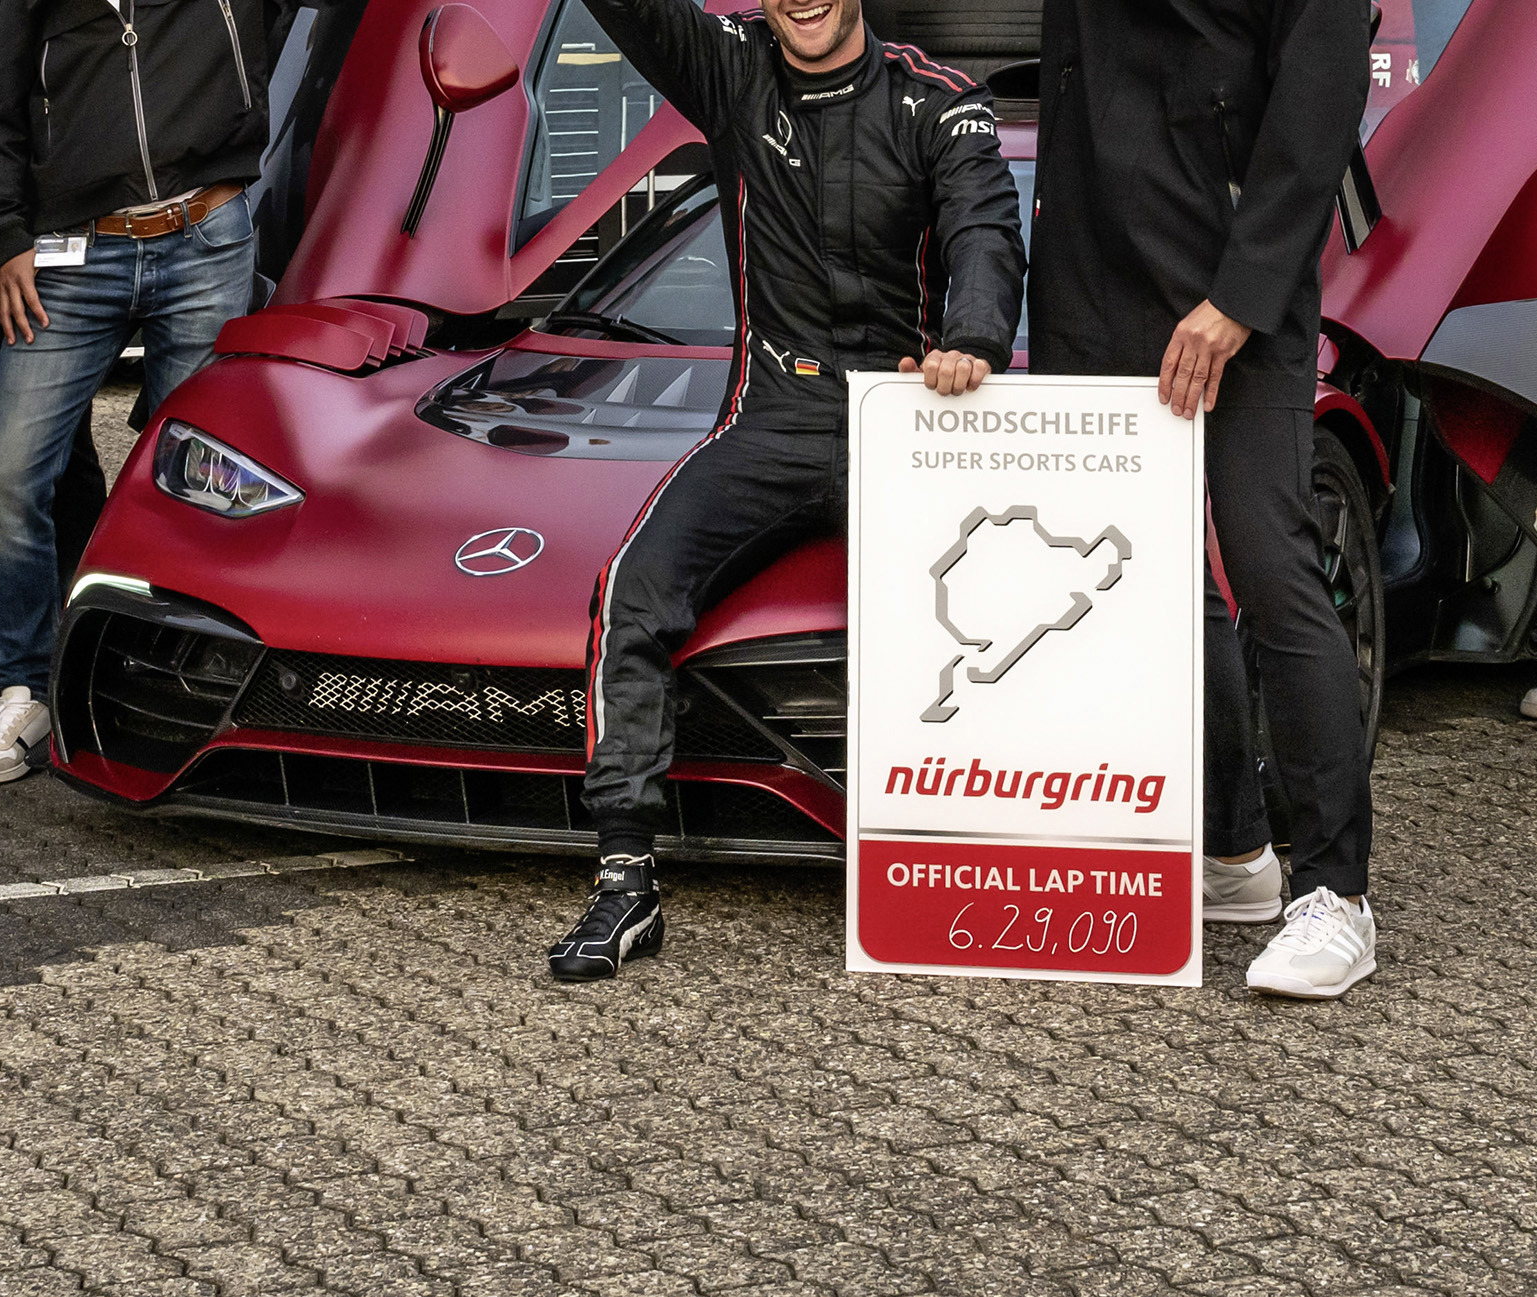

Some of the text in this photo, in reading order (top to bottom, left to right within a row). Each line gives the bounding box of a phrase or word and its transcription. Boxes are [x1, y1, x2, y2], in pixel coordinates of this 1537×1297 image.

[951, 119, 995, 137] msi
[914, 409, 1138, 436] NORDSCHLEIFE
[911, 451, 1142, 473] SUPER SPORTS CARS
[884, 756, 1166, 814] nürburgring
[886, 862, 1163, 897] OFFICIAL LAP TIME
